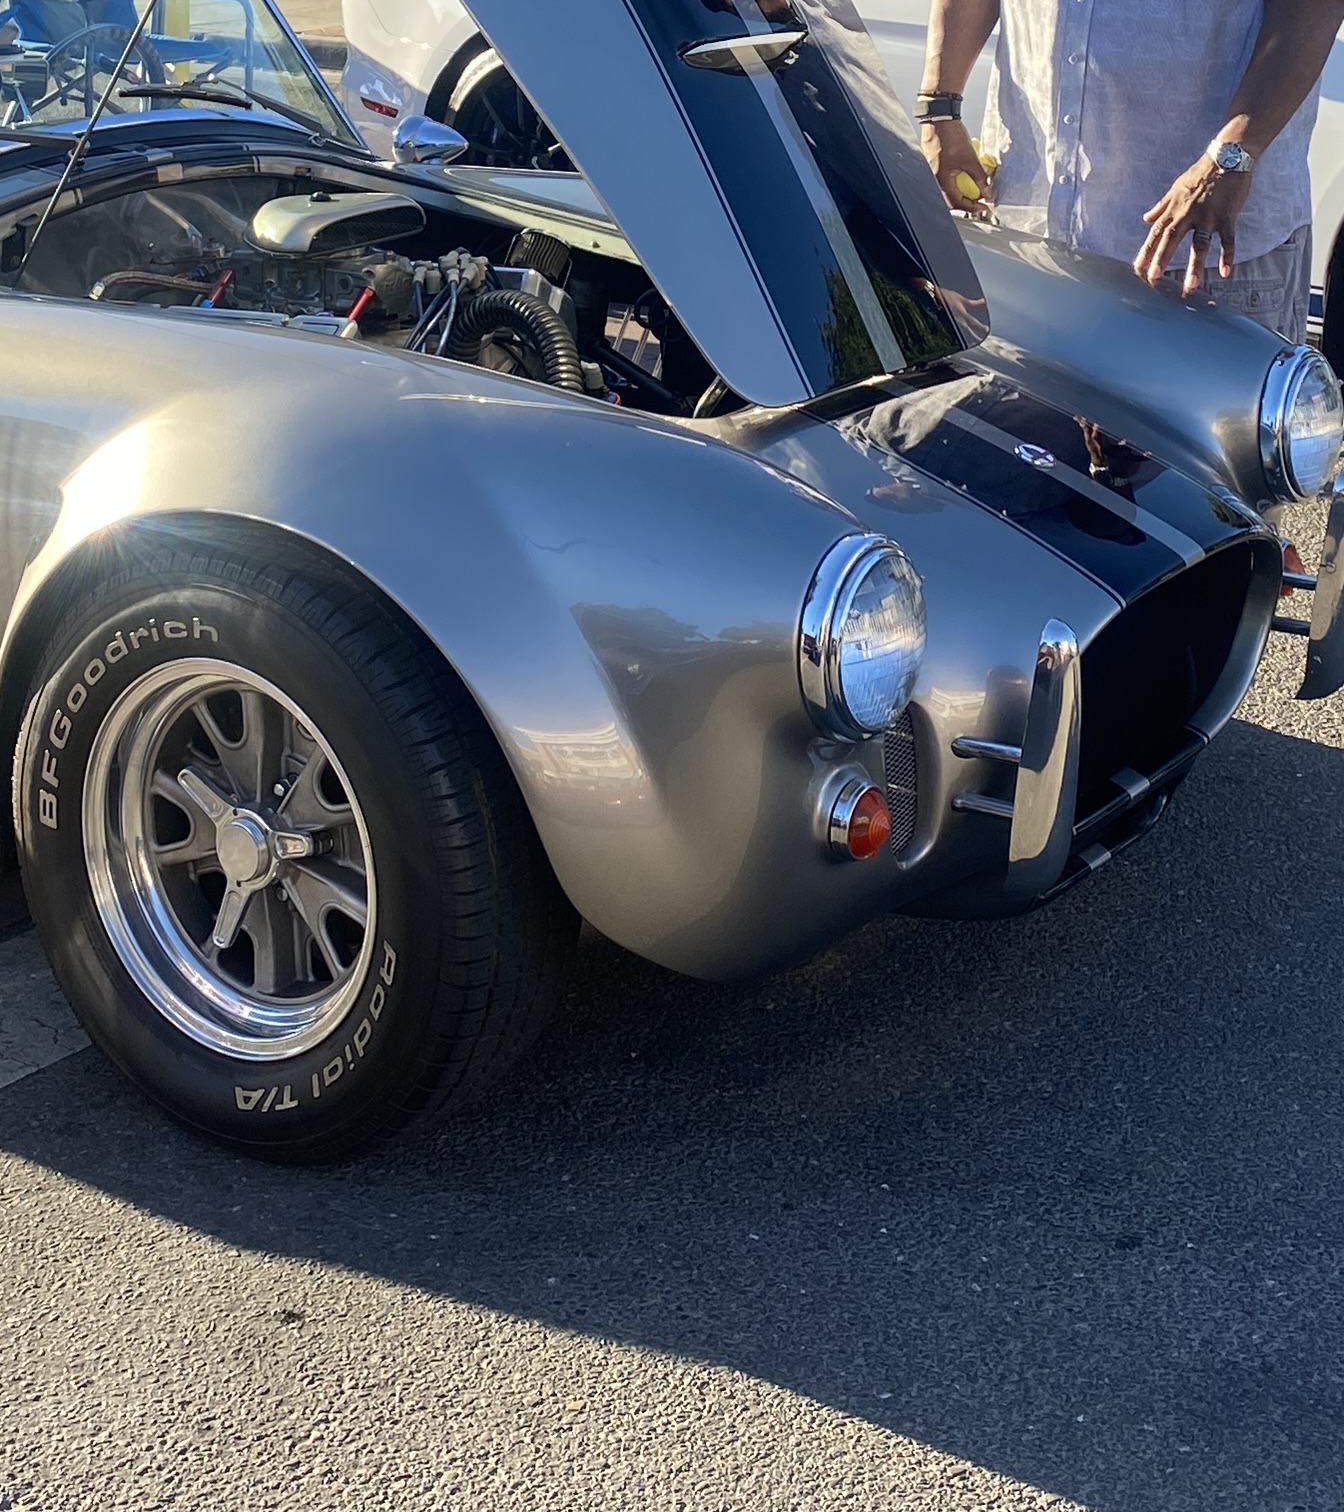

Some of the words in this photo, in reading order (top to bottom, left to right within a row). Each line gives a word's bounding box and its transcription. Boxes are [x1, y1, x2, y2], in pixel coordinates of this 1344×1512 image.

[38, 615, 219, 830] BFGoodrich
[233, 1084, 299, 1114] T/A
[312, 940, 398, 1099] Radial
